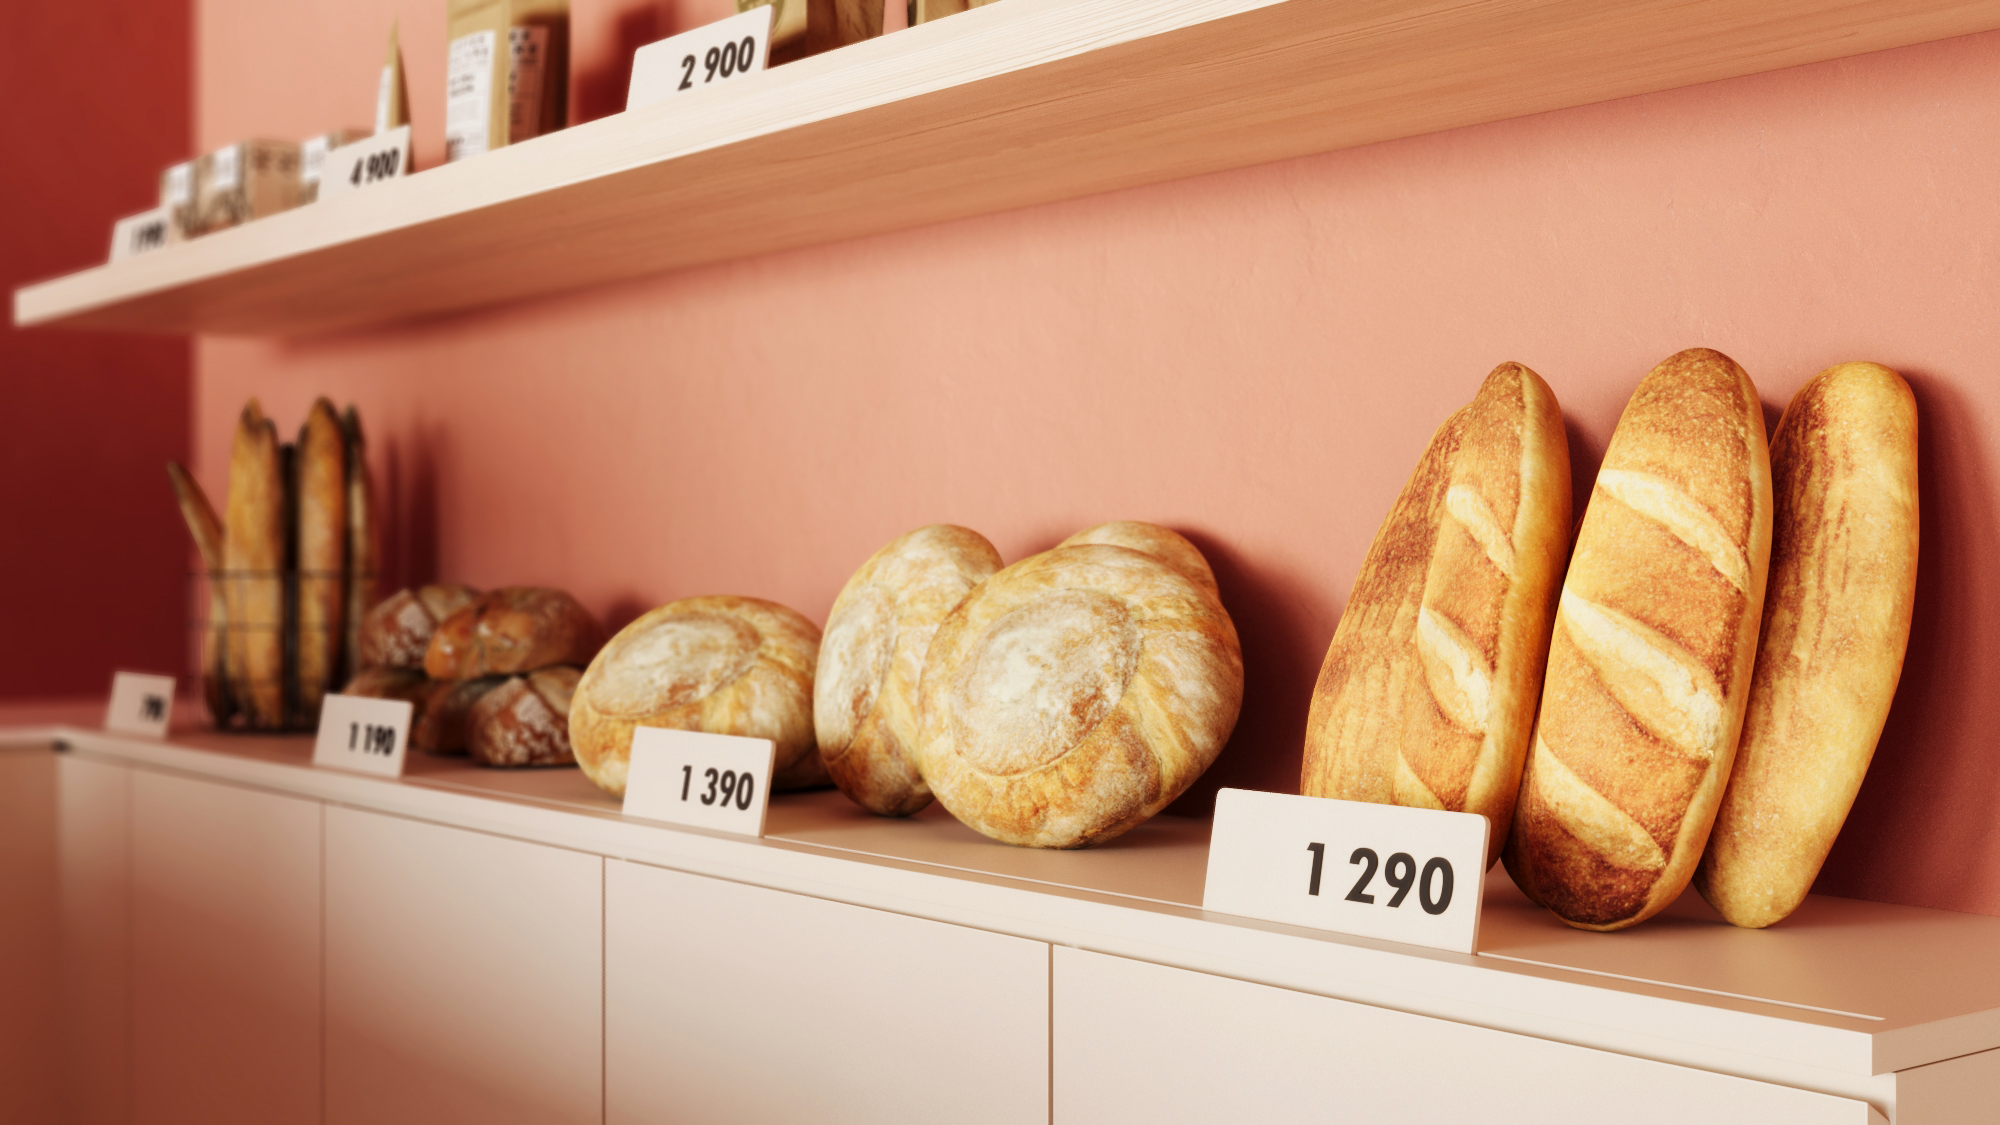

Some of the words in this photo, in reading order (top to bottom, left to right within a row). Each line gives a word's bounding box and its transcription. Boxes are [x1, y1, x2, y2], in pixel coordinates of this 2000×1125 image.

[678, 53, 696, 91] 2
[704, 35, 755, 83] 900
[349, 721, 359, 752] 1
[364, 723, 396, 757] 190
[681, 764, 693, 802] 1
[700, 767, 755, 811] 390
[1306, 841, 1326, 897] 1
[1344, 847, 1454, 915] 290
